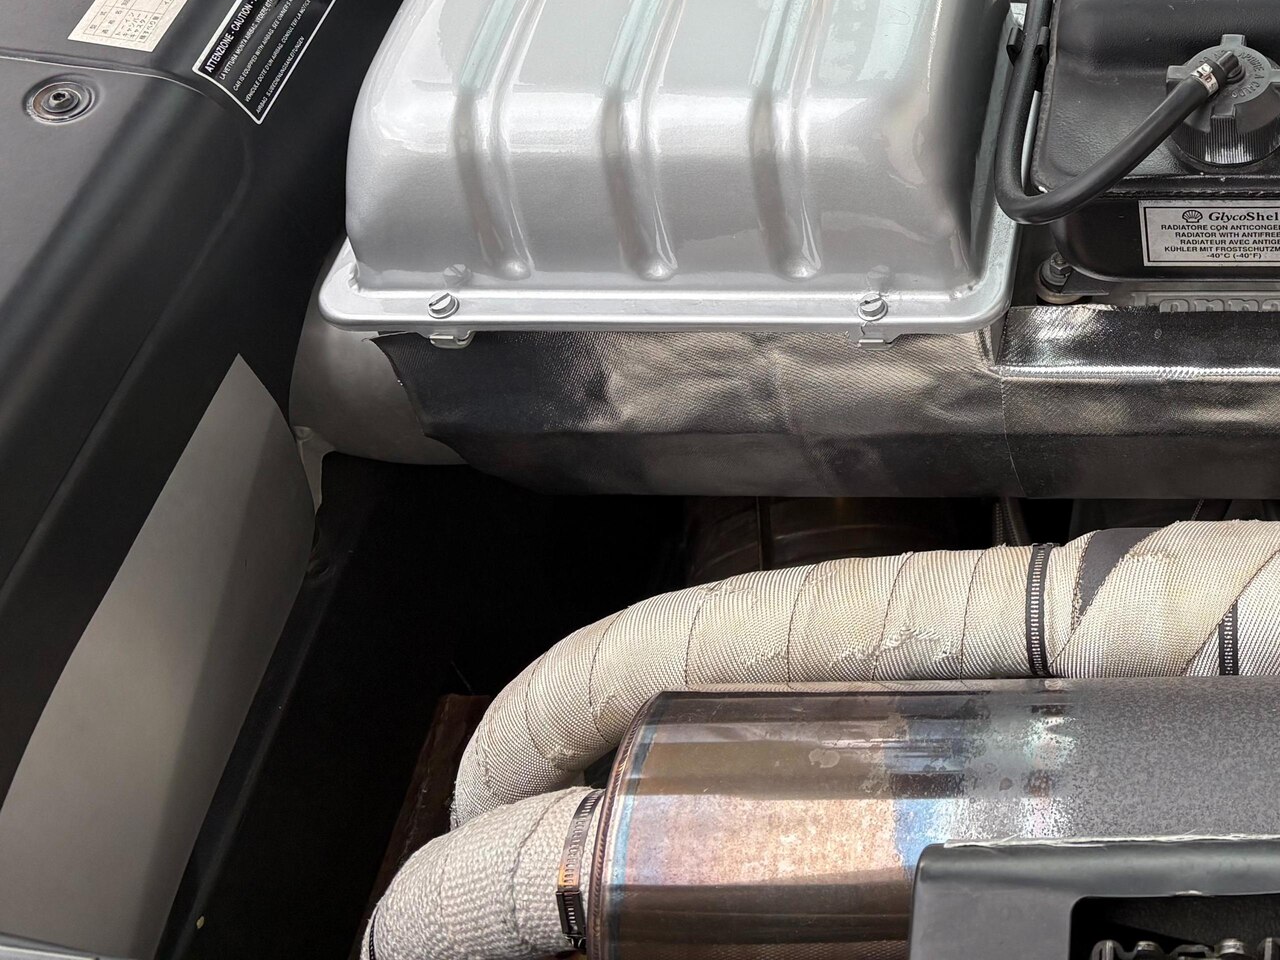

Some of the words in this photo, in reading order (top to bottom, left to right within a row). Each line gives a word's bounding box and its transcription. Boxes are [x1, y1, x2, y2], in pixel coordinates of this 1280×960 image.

[205, 32, 233, 72] ATTENZIONE
[231, 2, 252, 31] CAUTION
[223, 53, 237, 73] VETTURA
[235, 39, 247, 54] MONTA
[242, 54, 257, 76] EQUIPPED
[255, 44, 263, 55] WITH
